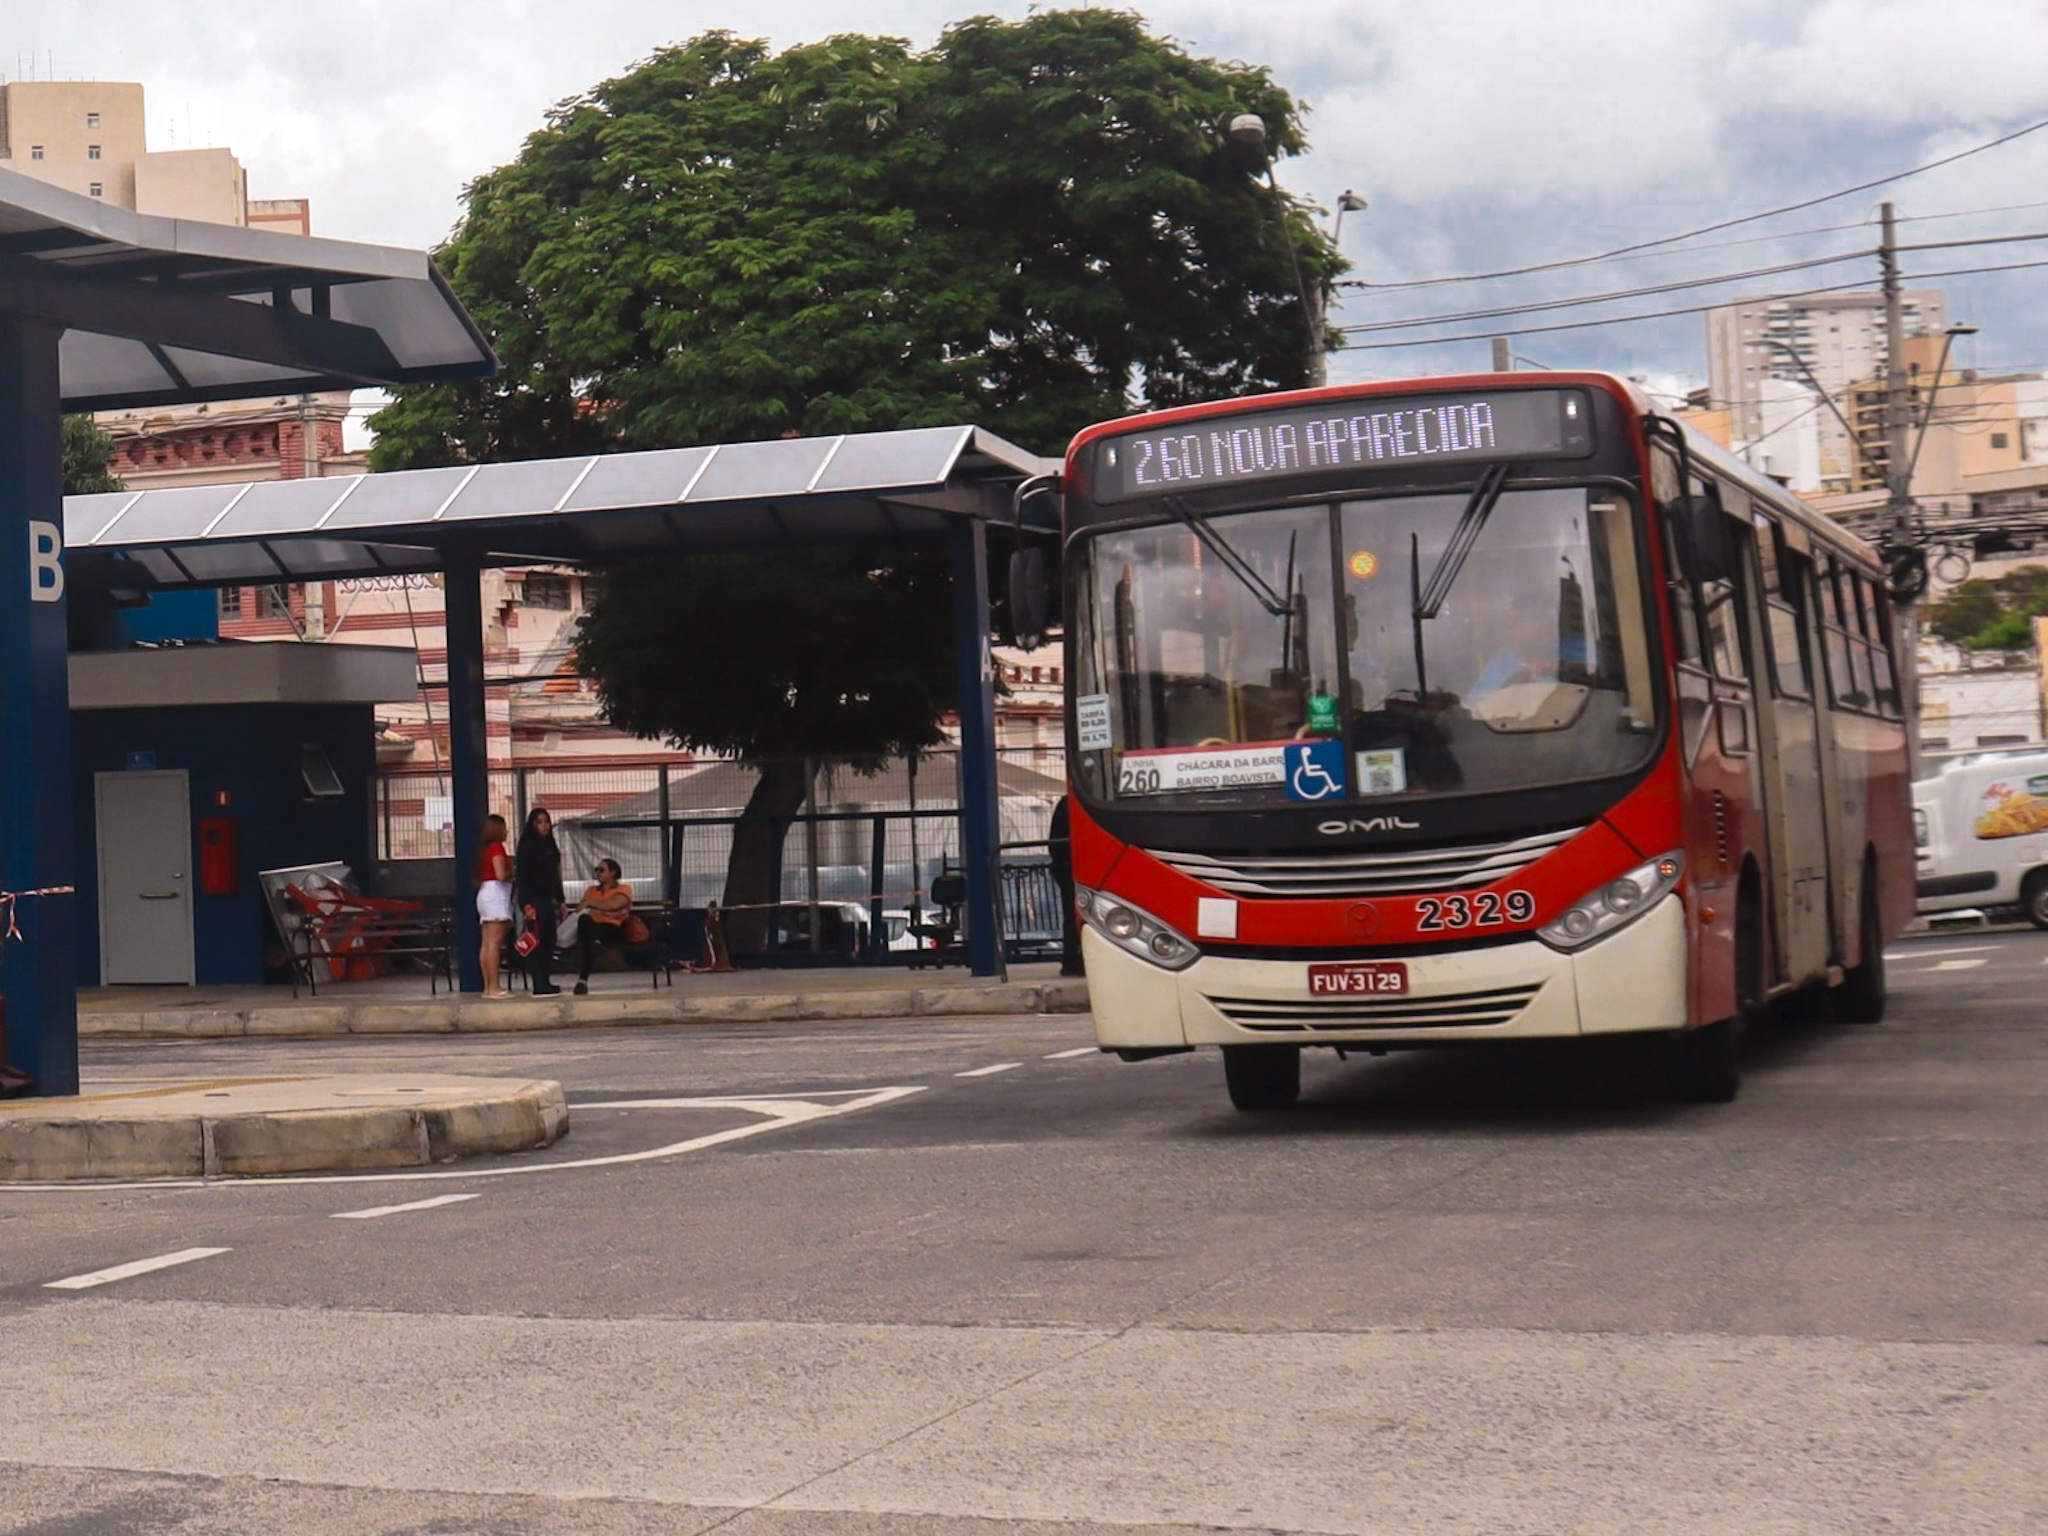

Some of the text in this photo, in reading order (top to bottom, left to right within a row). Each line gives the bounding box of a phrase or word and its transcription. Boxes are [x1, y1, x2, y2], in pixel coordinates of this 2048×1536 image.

[1210, 424, 1299, 476] NOVA
[1305, 402, 1496, 466] APARECIDA
[29, 520, 64, 602] B
[981, 635, 993, 682] A
[1121, 768, 1161, 793] 260
[1126, 758, 1156, 769] LINHA
[1176, 771, 1278, 787] BAIRRO BOAVISTA
[1177, 755, 1285, 772] CHÁCARA DA BARR
[1415, 889, 1536, 932] 2329
